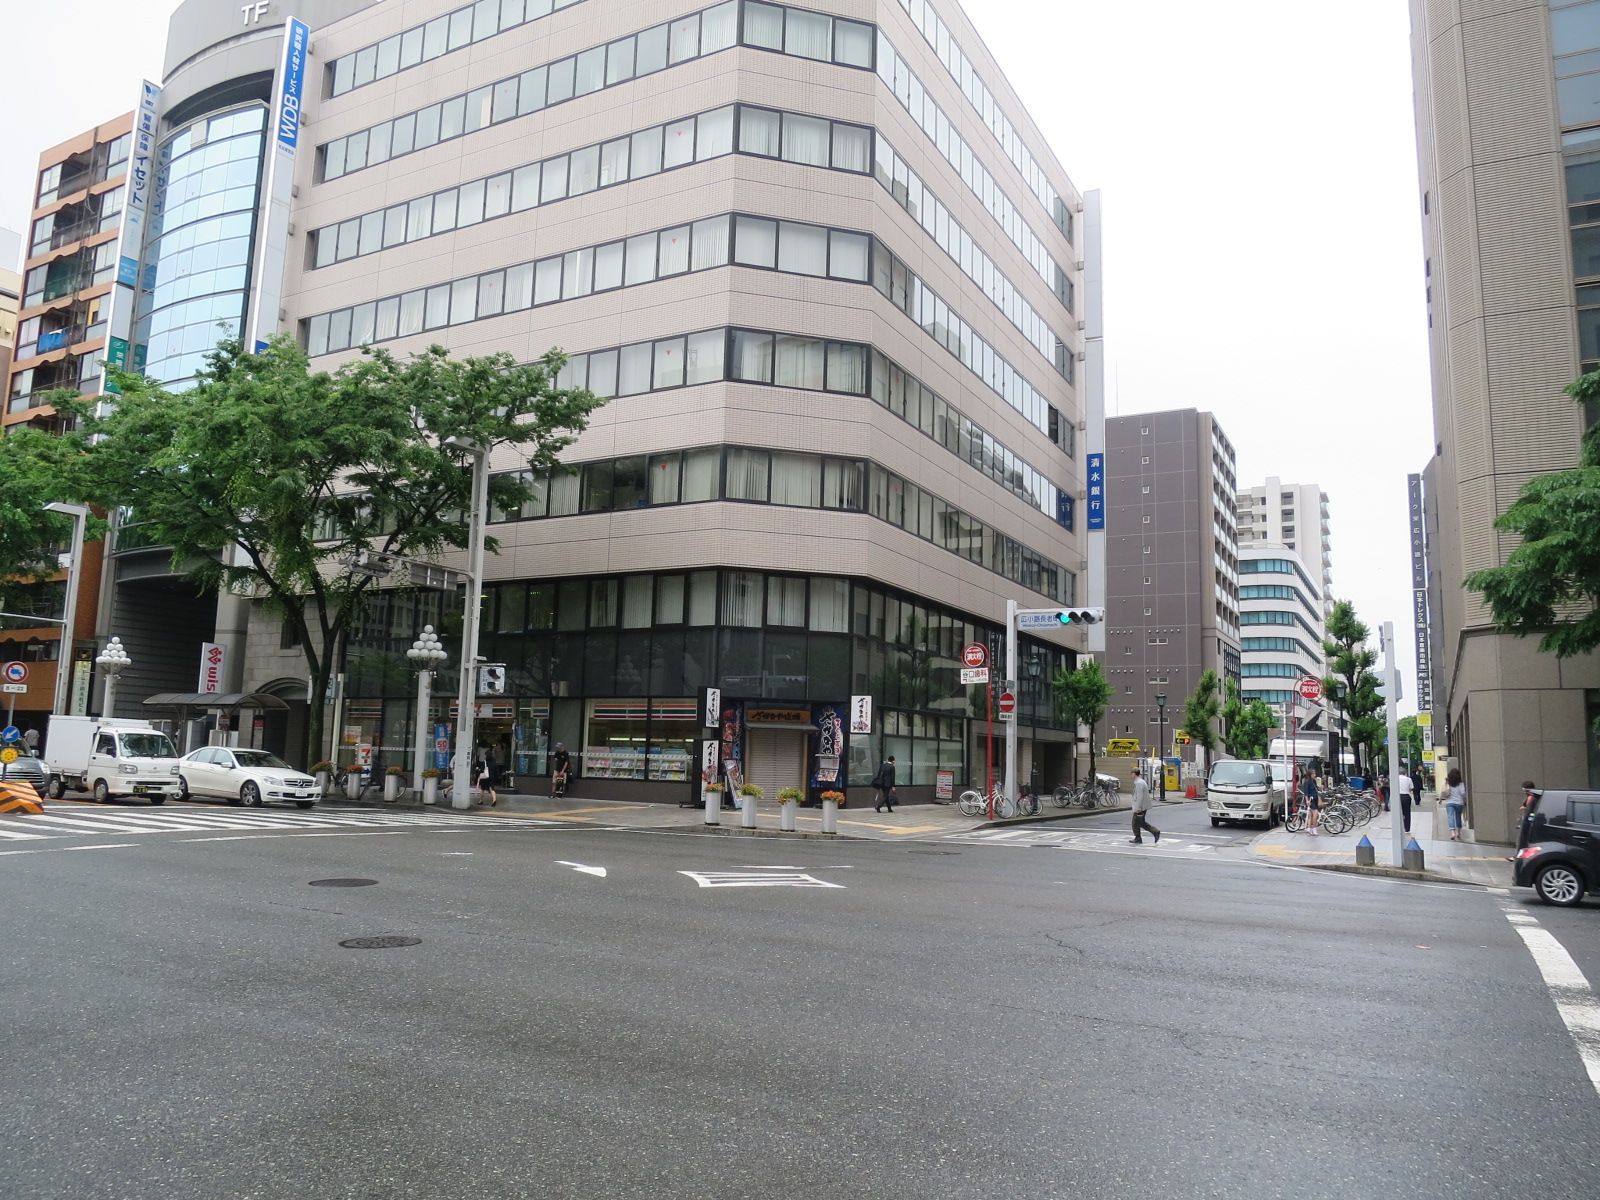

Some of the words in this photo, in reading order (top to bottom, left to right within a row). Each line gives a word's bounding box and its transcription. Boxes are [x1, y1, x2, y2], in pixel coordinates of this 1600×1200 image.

[241, 0, 269, 25] TF
[279, 93, 299, 139] WDB
[1090, 457, 1101, 510] 清水銀行
[206, 666, 219, 694] wis
